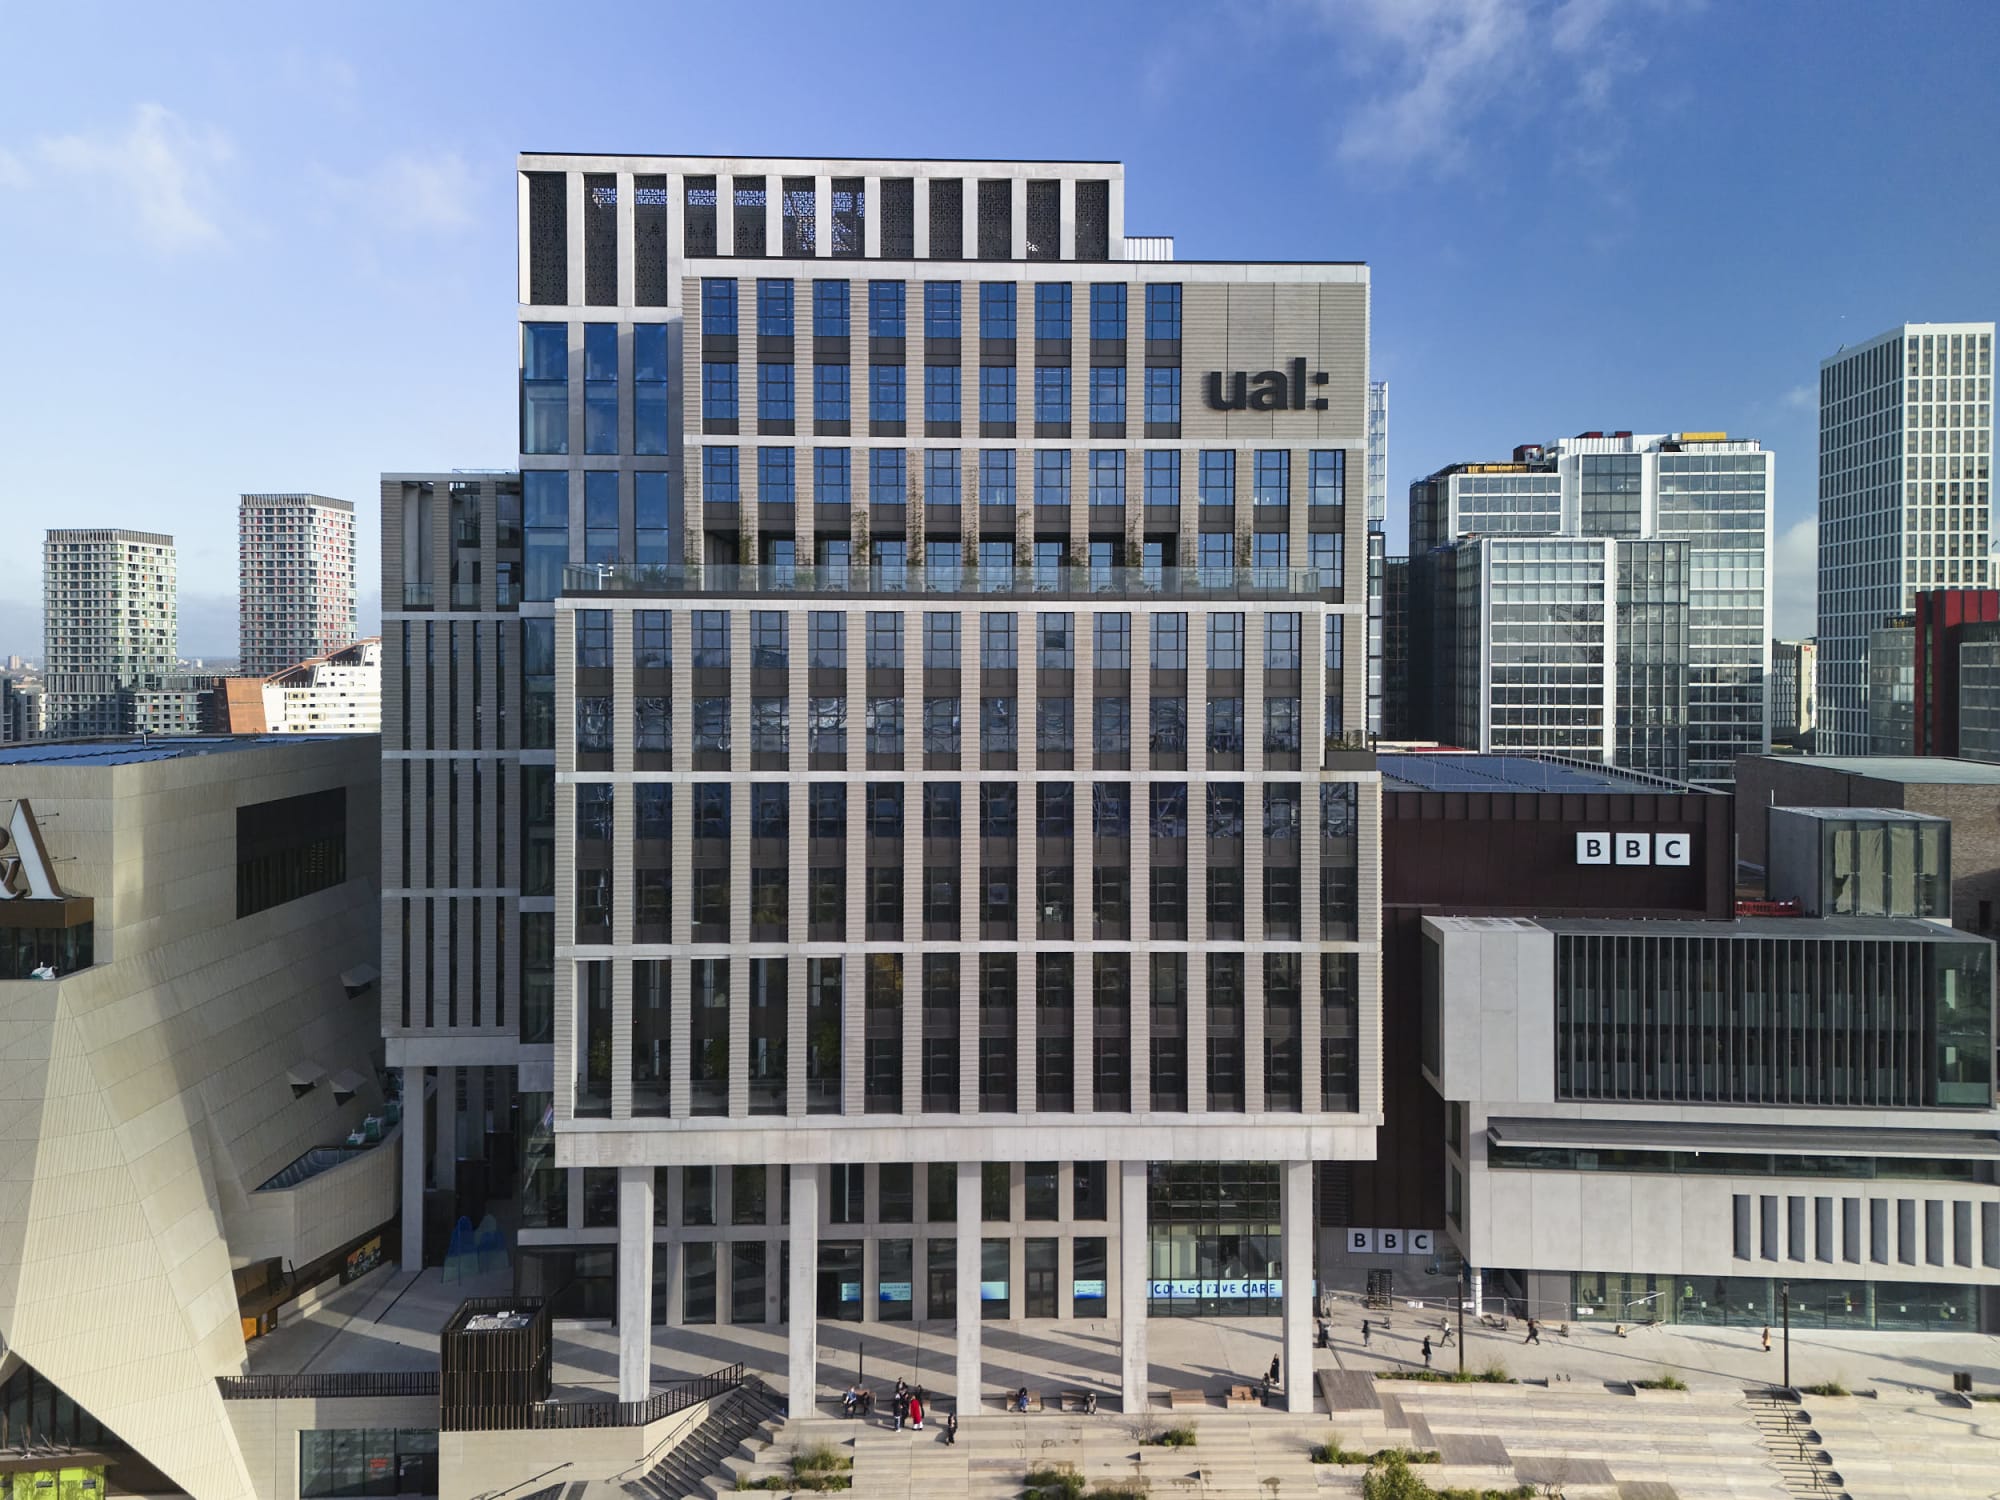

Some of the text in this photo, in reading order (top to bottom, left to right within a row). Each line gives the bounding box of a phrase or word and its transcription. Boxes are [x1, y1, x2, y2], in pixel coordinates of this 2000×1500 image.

[1209, 357, 1329, 411] ual:
[1586, 838, 1682, 860] BBC
[1353, 1232, 1428, 1250] BBC
[1241, 1283, 1276, 1295] CARE
